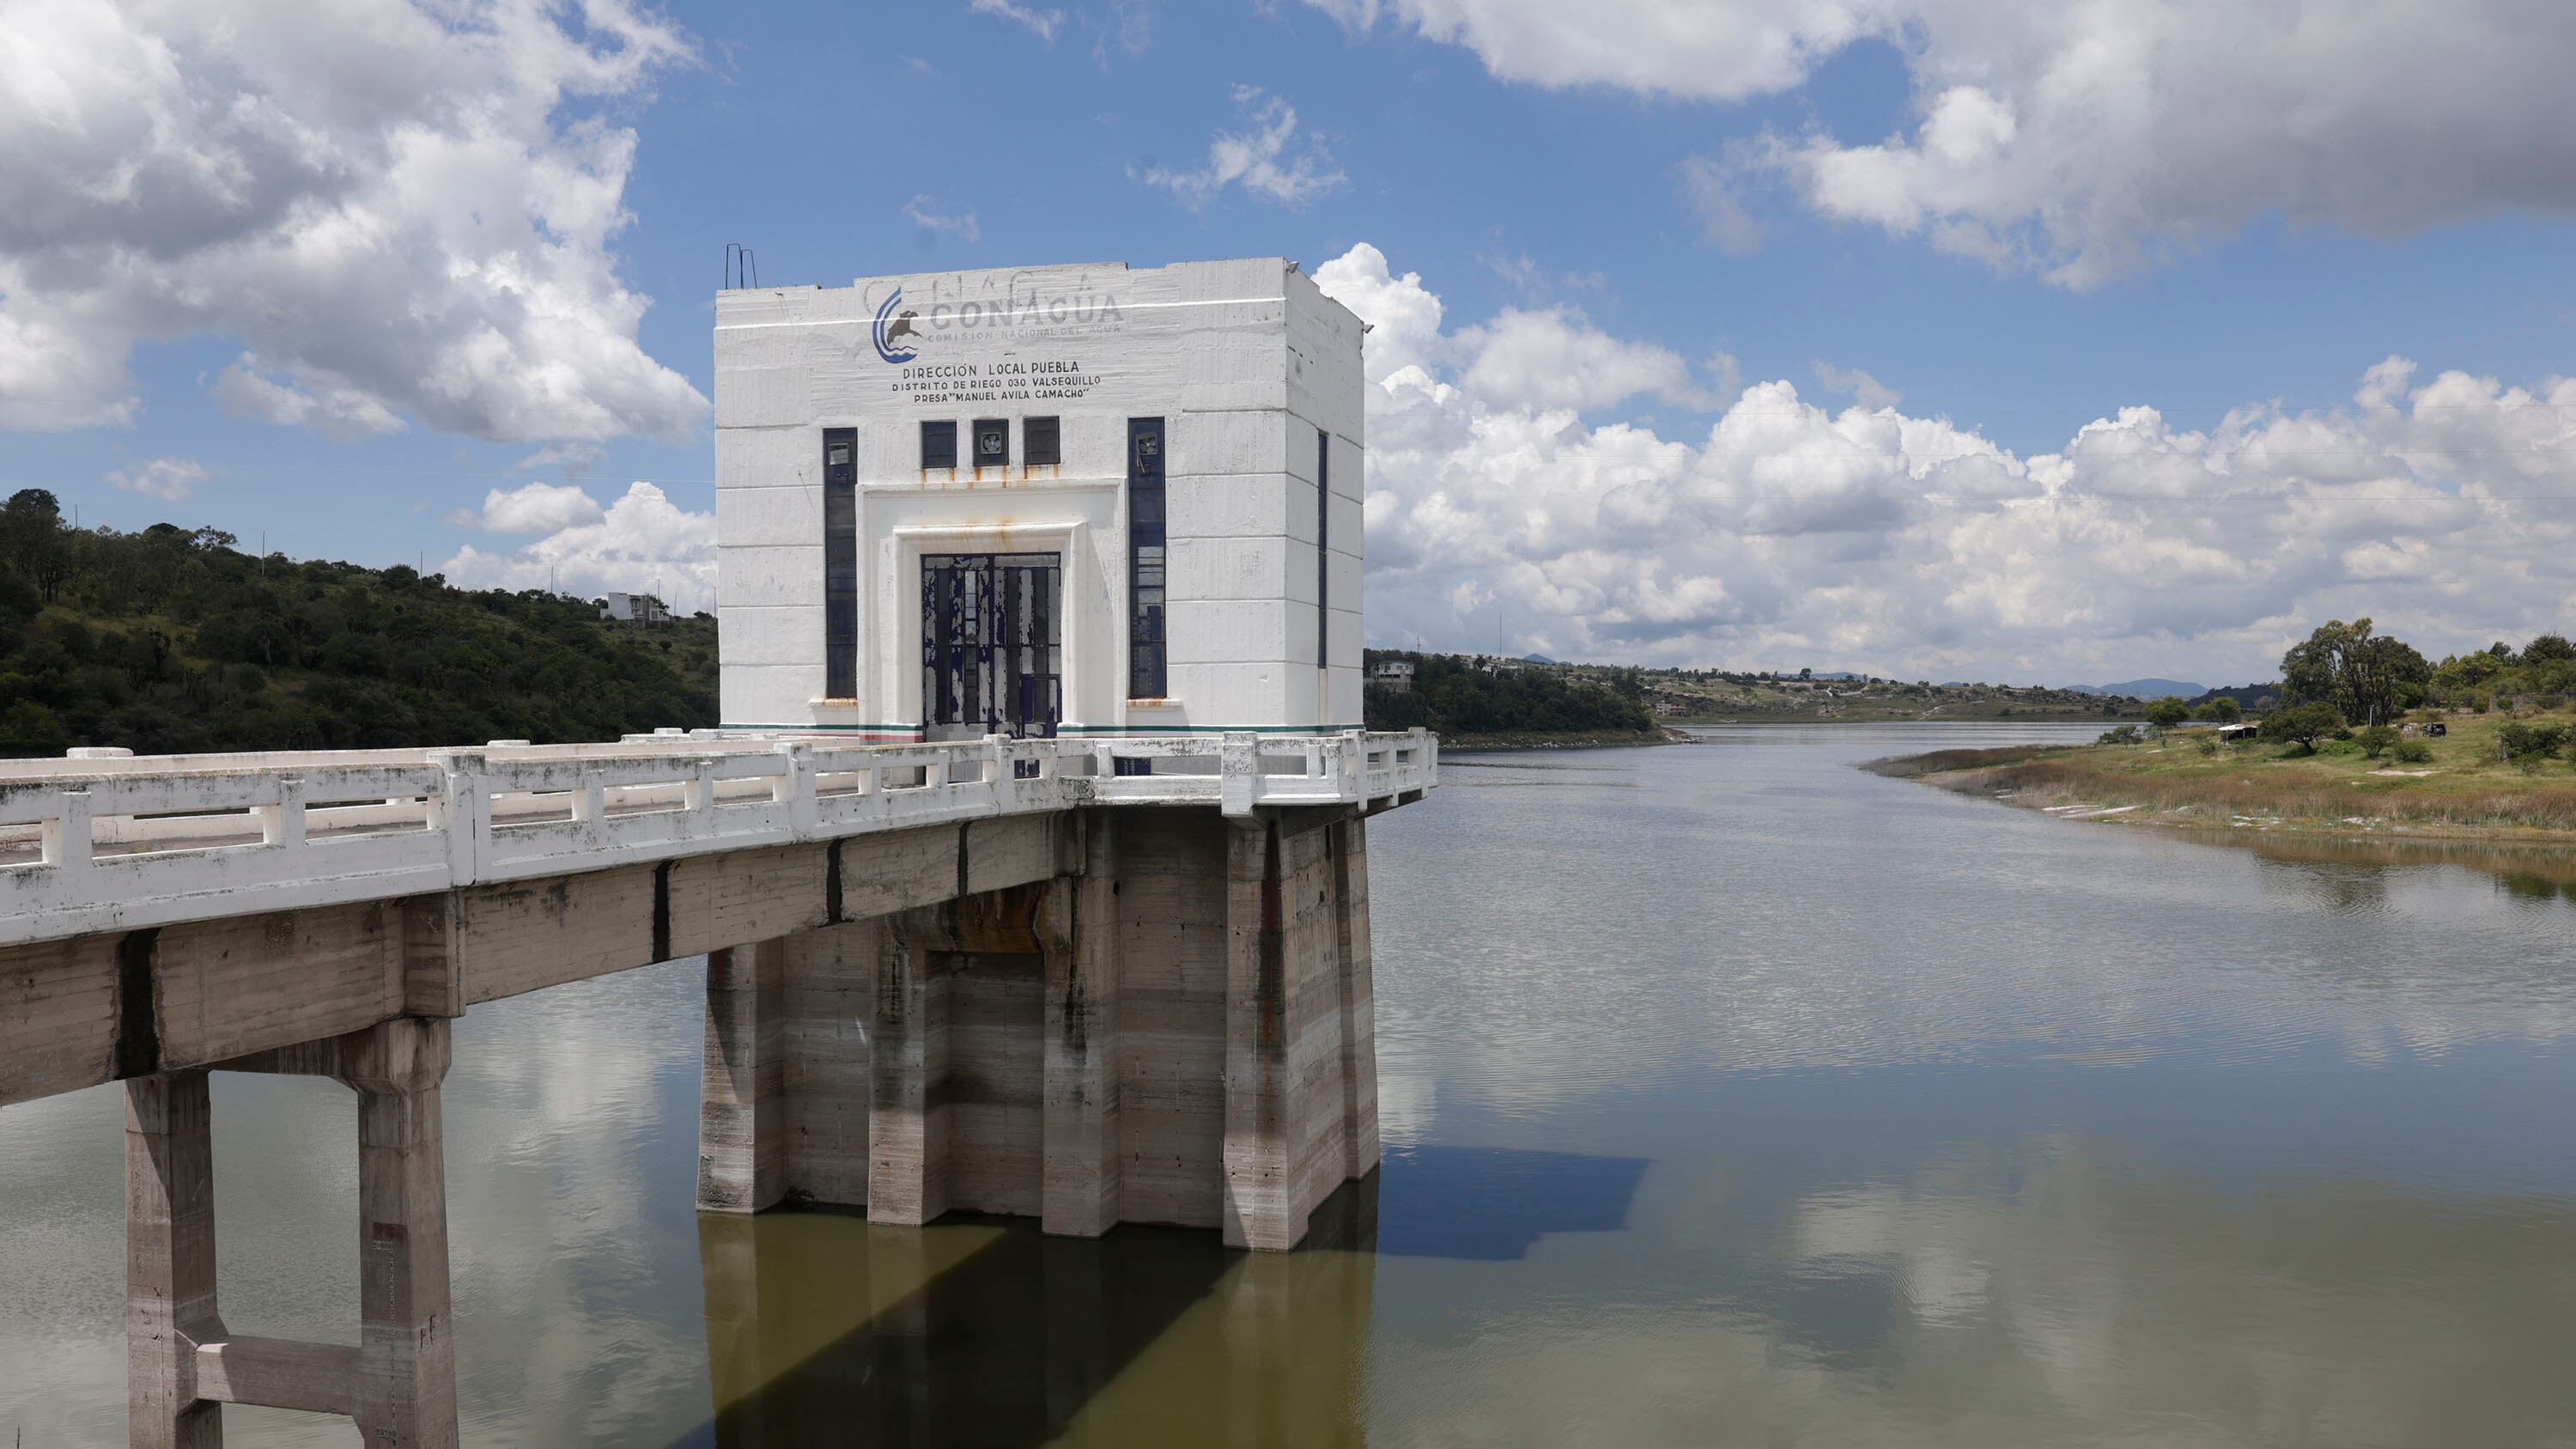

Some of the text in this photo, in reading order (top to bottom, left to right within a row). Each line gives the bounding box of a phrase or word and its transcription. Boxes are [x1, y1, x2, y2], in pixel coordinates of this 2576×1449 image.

[929, 294, 1124, 331] CONAGUA
[927, 324, 1121, 344] COMISION NACIONAL DEL AGUA
[902, 361, 1079, 380] DIRECCIÓN LOCAL PUEBLA
[892, 376, 1101, 392] DISTRITO DE RIEGO 030 VALSEQUILLO
[914, 393, 948, 403] PRESA
[1001, 389, 1030, 400] AVILA
